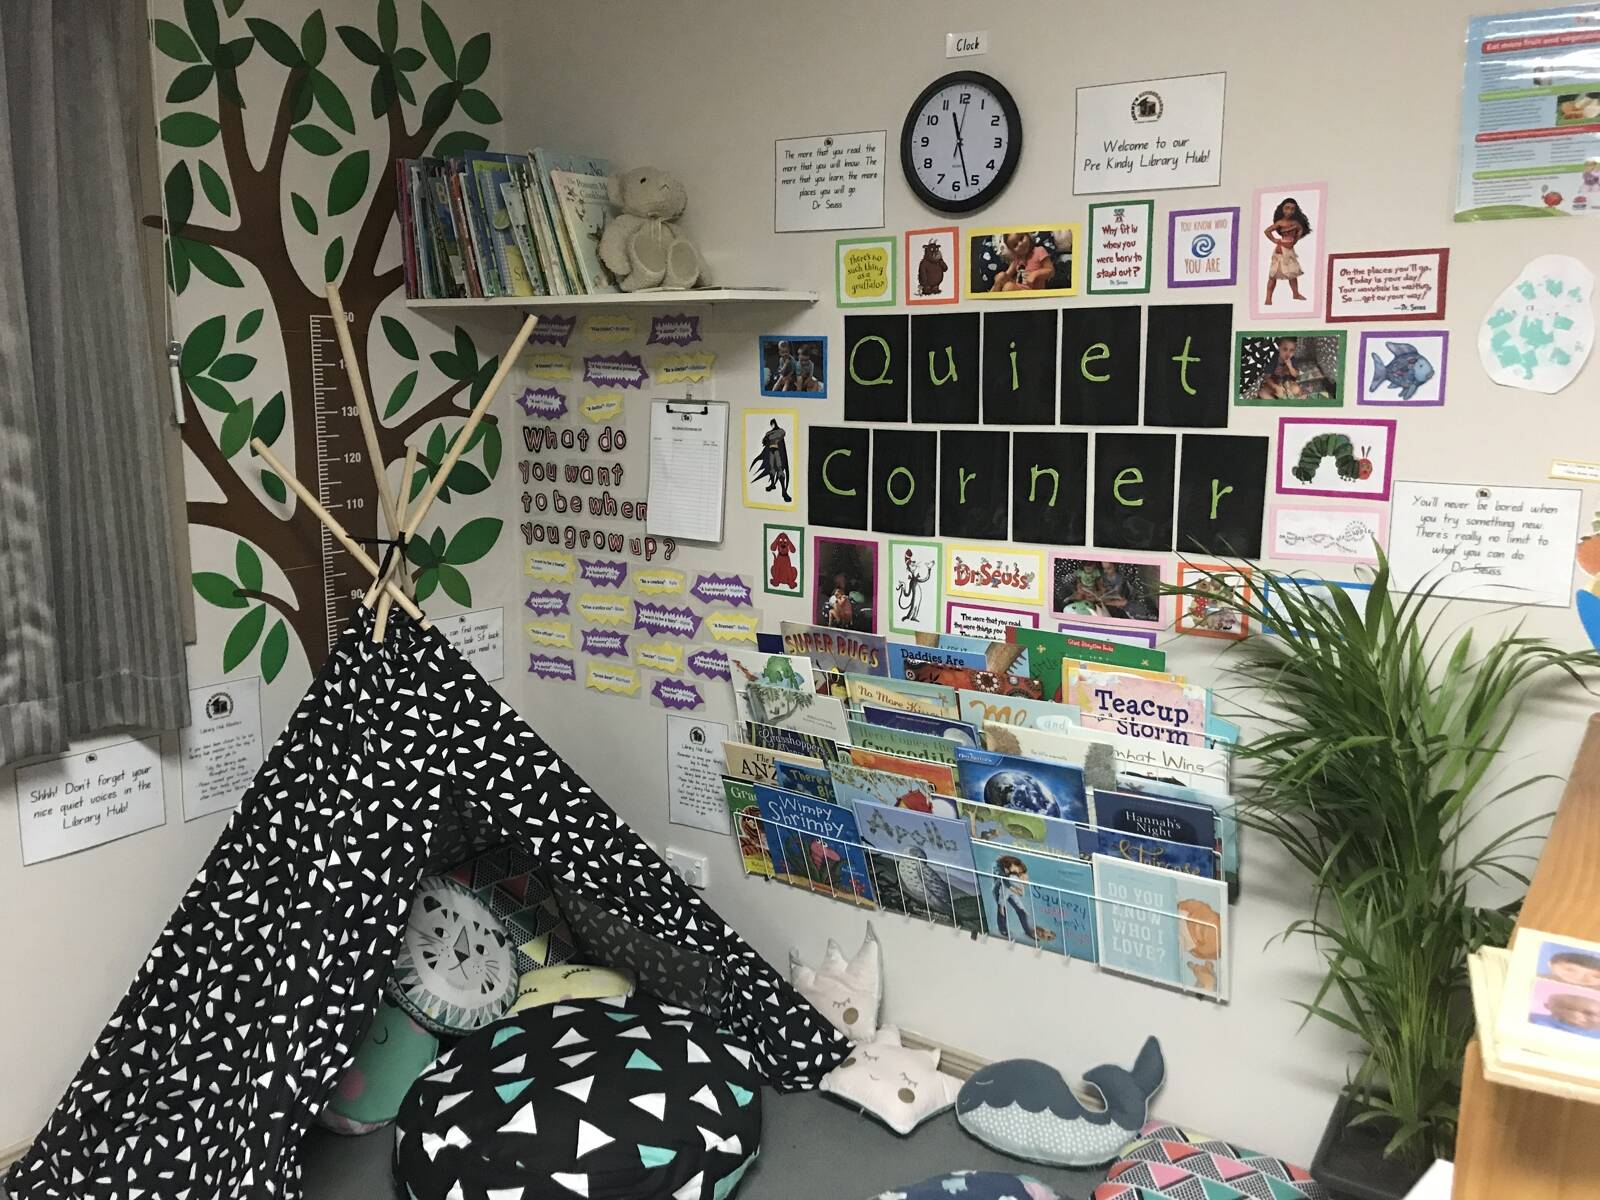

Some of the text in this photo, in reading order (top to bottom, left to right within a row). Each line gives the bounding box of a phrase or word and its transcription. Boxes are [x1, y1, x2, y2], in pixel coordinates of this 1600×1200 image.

[957, 37, 979, 52] Clock
[943, 100, 949, 111] 11
[960, 93, 971, 104] 12
[981, 99, 985, 110] 1
[927, 115, 938, 125] 10
[991, 116, 1000, 126] 2
[921, 137, 929, 147] 9
[994, 138, 1002, 148] 3
[1104, 137, 1189, 152] Welcome to our
[785, 150, 794, 159] The
[817, 147, 828, 157] that
[833, 149, 843, 159] you
[847, 145, 860, 154] read
[866, 144, 875, 152] the
[801, 162, 812, 170] that
[816, 163, 826, 173] you
[830, 160, 840, 168] will
[866, 156, 877, 165] The
[924, 158, 932, 169] 8
[986, 160, 995, 170] 4
[1084, 150, 1210, 173] Pre Kindy Library Hub!
[815, 177, 825, 186] you
[849, 171, 857, 180] the
[937, 174, 945, 184] 7
[952, 181, 960, 191] 6
[971, 175, 979, 185] 5
[799, 185, 856, 199] places you will go
[812, 200, 842, 209] Dr Seuss
[1102, 225, 1129, 236] Why fit
[1103, 240, 1136, 250] when you
[850, 253, 871, 265] There's
[1115, 252, 1131, 262] born
[1134, 252, 1142, 262] to
[848, 262, 884, 275] such thing
[1096, 266, 1140, 278] stand out?
[1185, 258, 1220, 274] YOU ARE
[1340, 268, 1350, 276] Oh
[1367, 266, 1392, 276] places
[1348, 277, 1372, 285] Today
[1403, 273, 1422, 281] day!
[1407, 292, 1427, 300] way!
[849, 334, 1202, 396] Quiet
[341, 407, 359, 417] 130
[599, 426, 627, 452] do
[344, 453, 361, 463] 120
[519, 460, 623, 486] you want
[346, 499, 364, 510] 110
[521, 490, 647, 520] to be when
[1411, 496, 1438, 507] You'll
[1477, 499, 1488, 510] be
[1495, 501, 1523, 512] bored
[1530, 506, 1558, 514] when
[1420, 514, 1515, 531] you try something
[520, 522, 559, 545] you
[564, 526, 624, 552] grow
[1416, 526, 1448, 539] There's
[1456, 532, 1481, 545] really
[1507, 534, 1530, 545] limit
[1539, 537, 1549, 546] to
[1432, 545, 1457, 554] what
[1464, 549, 1480, 560] you
[1451, 561, 1502, 575] Dr Seuss
[351, 589, 362, 599] 90
[961, 613, 971, 621] The
[986, 616, 998, 625] that
[998, 618, 1007, 626] you
[785, 633, 879, 668] SUPER BUGS
[901, 649, 964, 666] Daddies Are
[858, 685, 903, 707] No More
[759, 728, 825, 756] Grasshoppers
[755, 753, 769, 763] The
[1163, 751, 1204, 772] Wins
[31, 767, 151, 803] Shhh! Don't forget your
[34, 808, 53, 819] nice
[60, 797, 83, 815] quiet
[91, 791, 117, 804] voices
[138, 781, 151, 791] the
[63, 802, 128, 829] Library Hub!
[779, 796, 832, 820] Wimpy
[768, 800, 844, 838] Shrimpy
[1126, 811, 1181, 830] Hannah's
[1136, 823, 1172, 838] Night
[1108, 883, 1164, 906] DO YOU
[1112, 919, 1164, 945] WHO I
[1112, 937, 1165, 962] LOVE?
